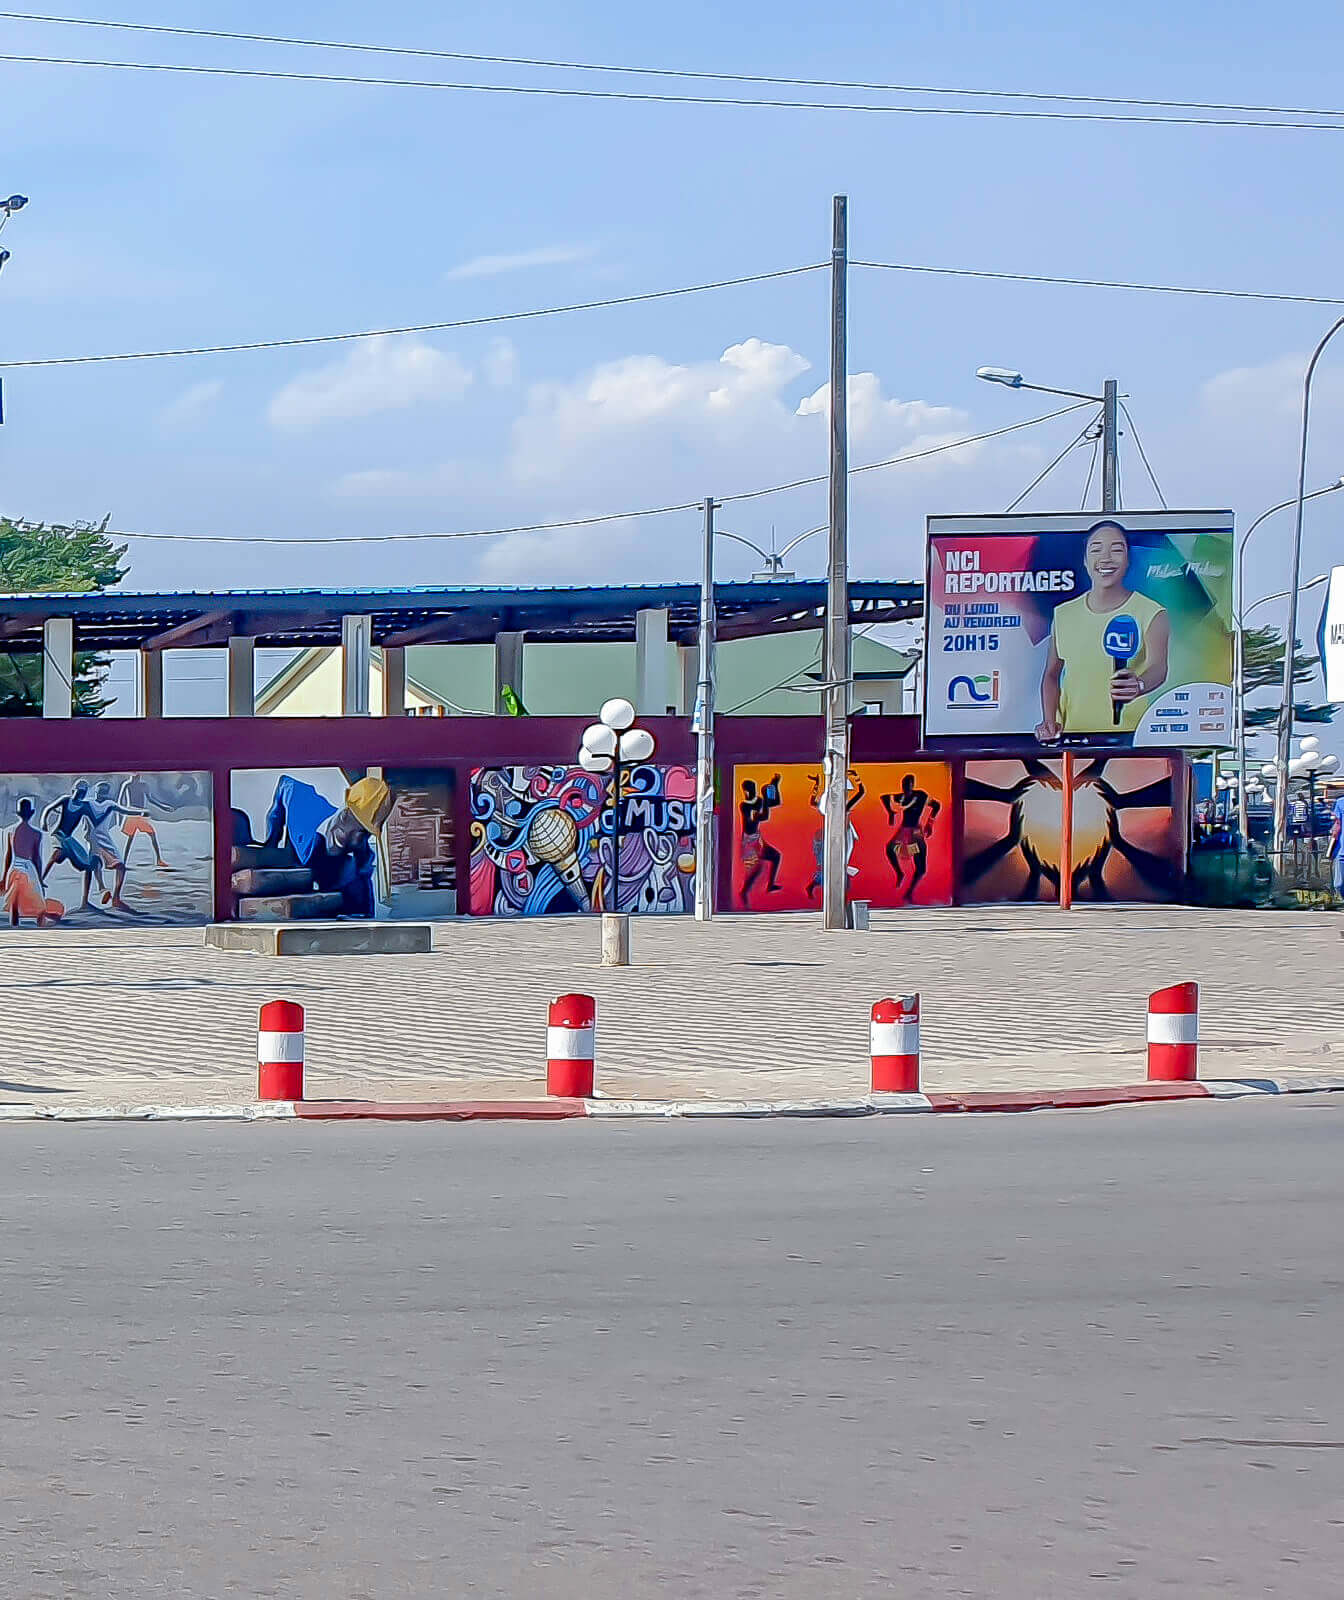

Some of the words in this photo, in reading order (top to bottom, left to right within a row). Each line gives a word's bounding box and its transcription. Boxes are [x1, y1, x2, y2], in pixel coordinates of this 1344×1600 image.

[945, 551, 980, 572] NCI
[944, 570, 1075, 593] REPORTAGES
[964, 602, 999, 615] LUNDI
[944, 617, 960, 628] AU
[963, 615, 1021, 628] VENDREDI
[943, 634, 1000, 651] 20H15
